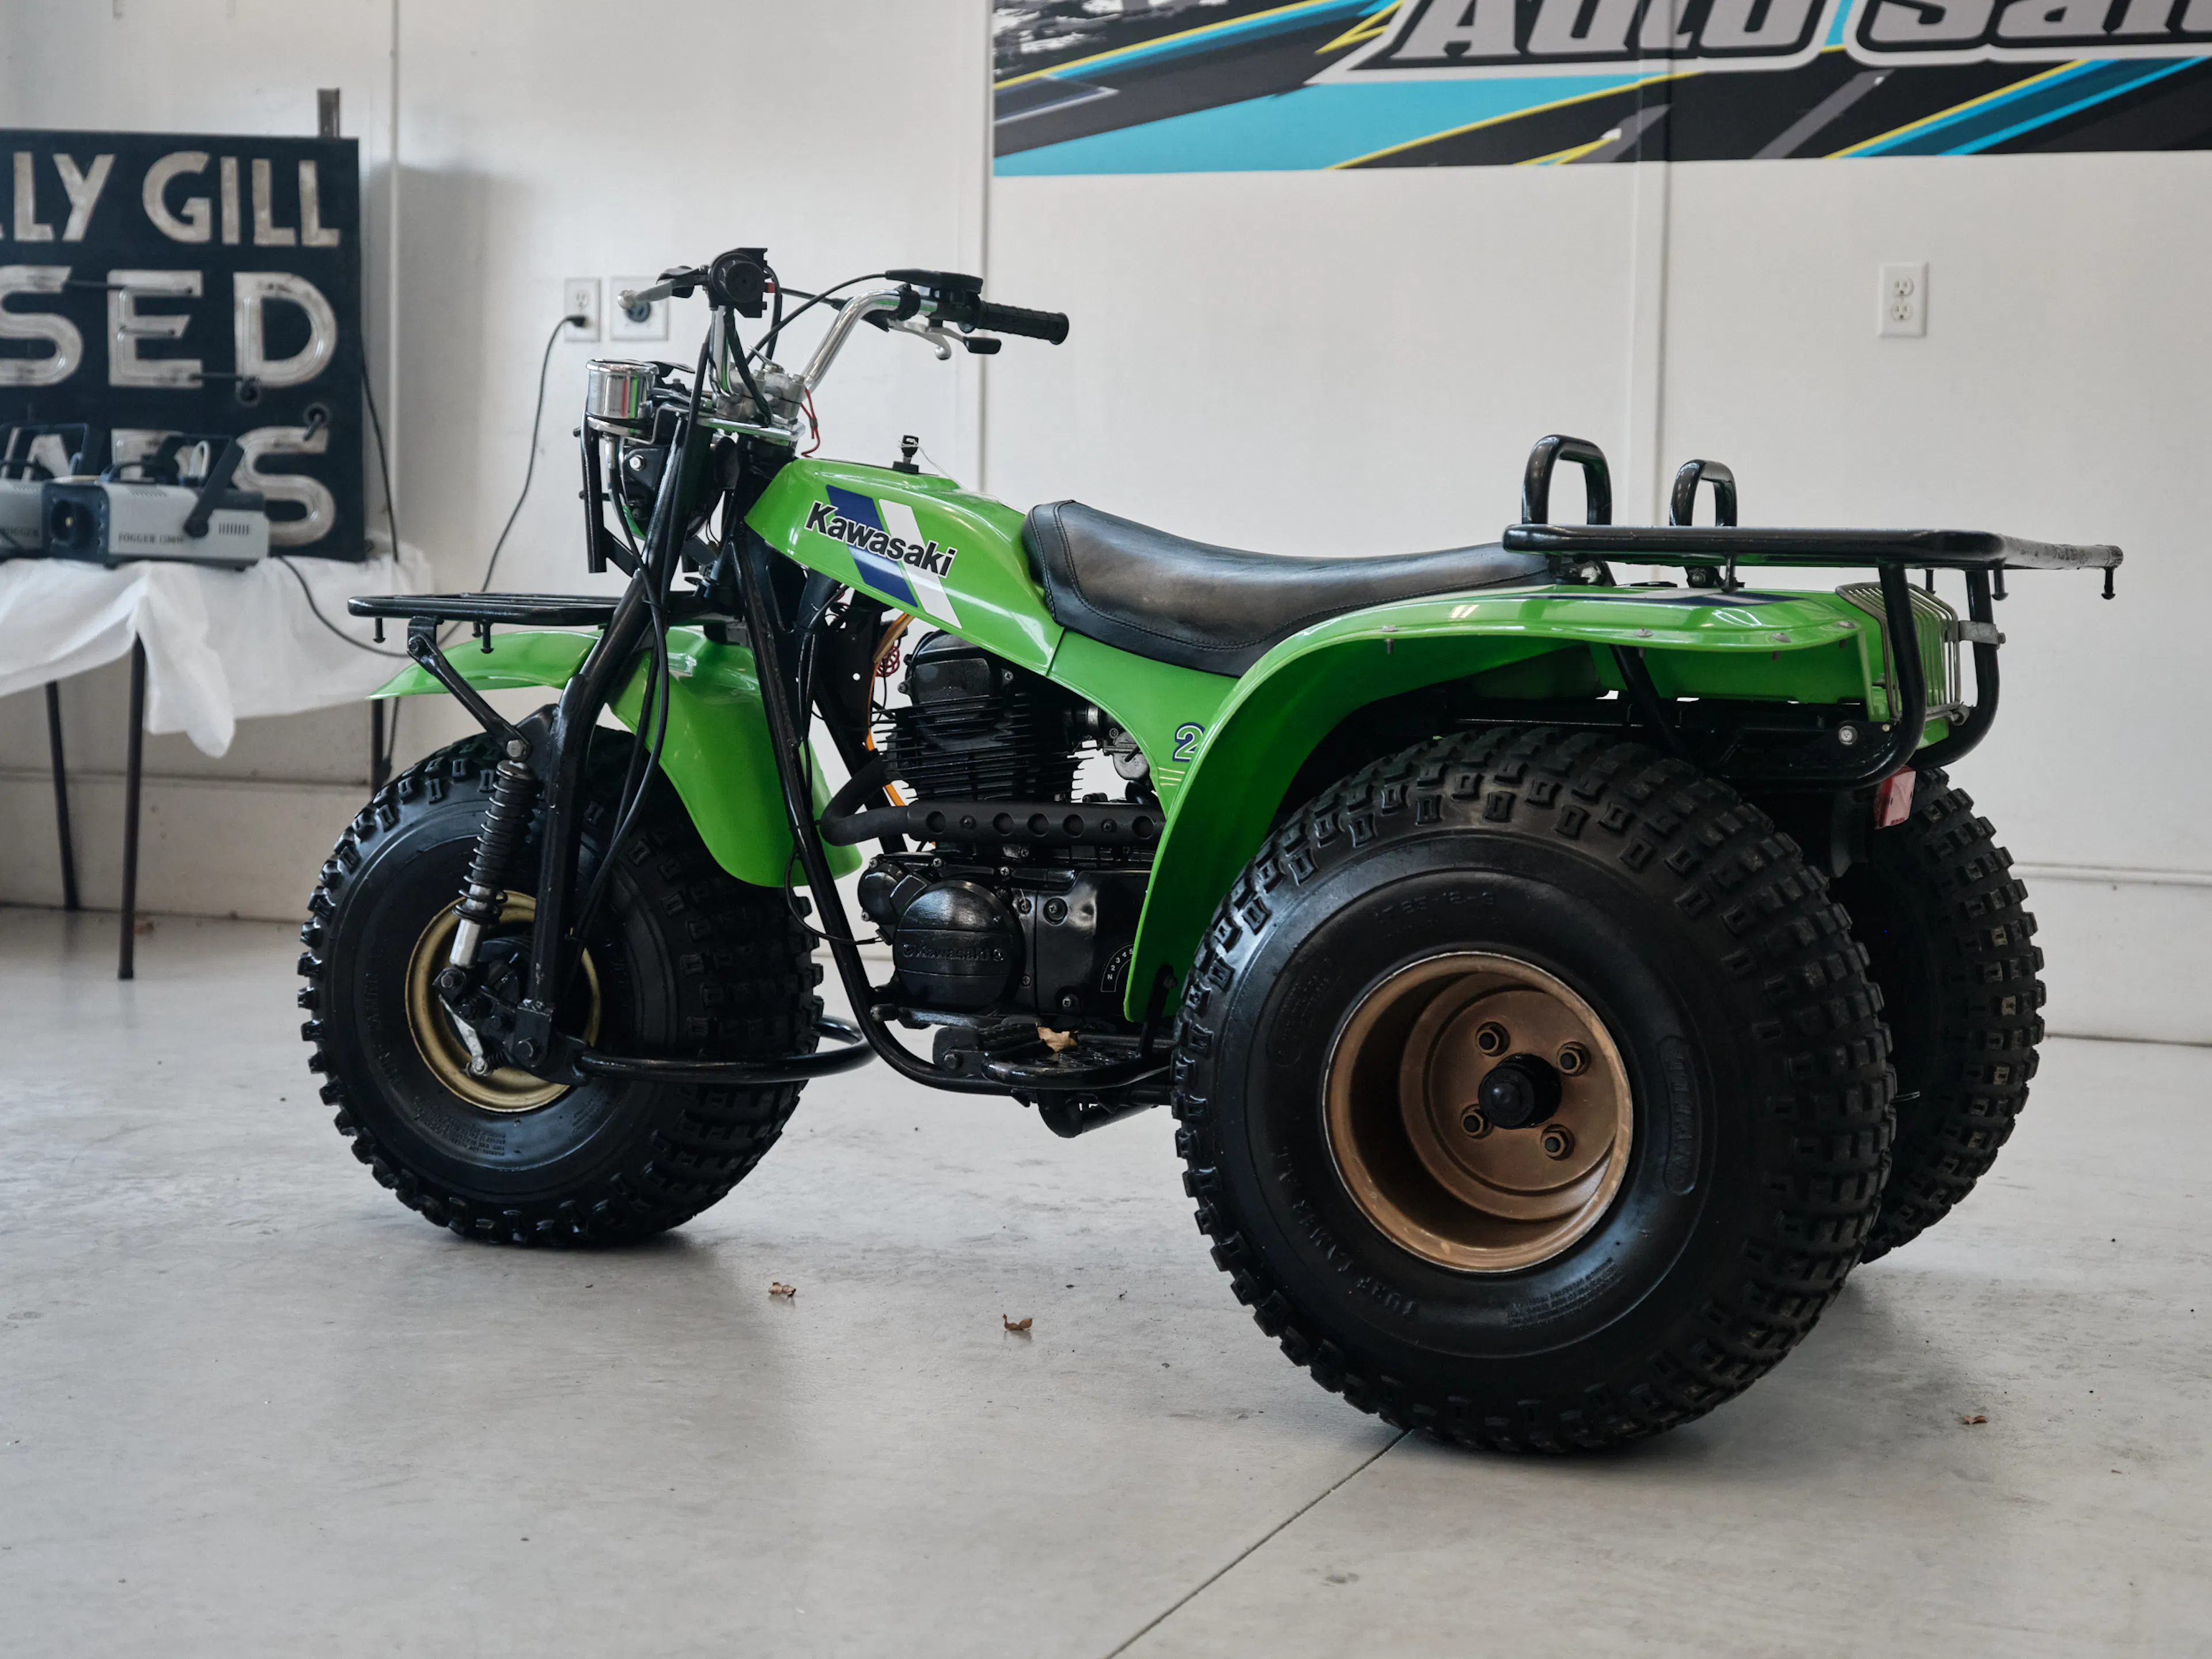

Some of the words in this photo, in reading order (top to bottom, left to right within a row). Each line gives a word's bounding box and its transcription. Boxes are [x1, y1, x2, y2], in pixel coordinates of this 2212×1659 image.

[1869, 0, 2212, 42] Sal
[0, 151, 115, 242] LY
[142, 151, 340, 247] GILL
[0, 264, 336, 387] SED
[805, 501, 958, 578] Kawasaki
[1172, 722, 1205, 762] 2
